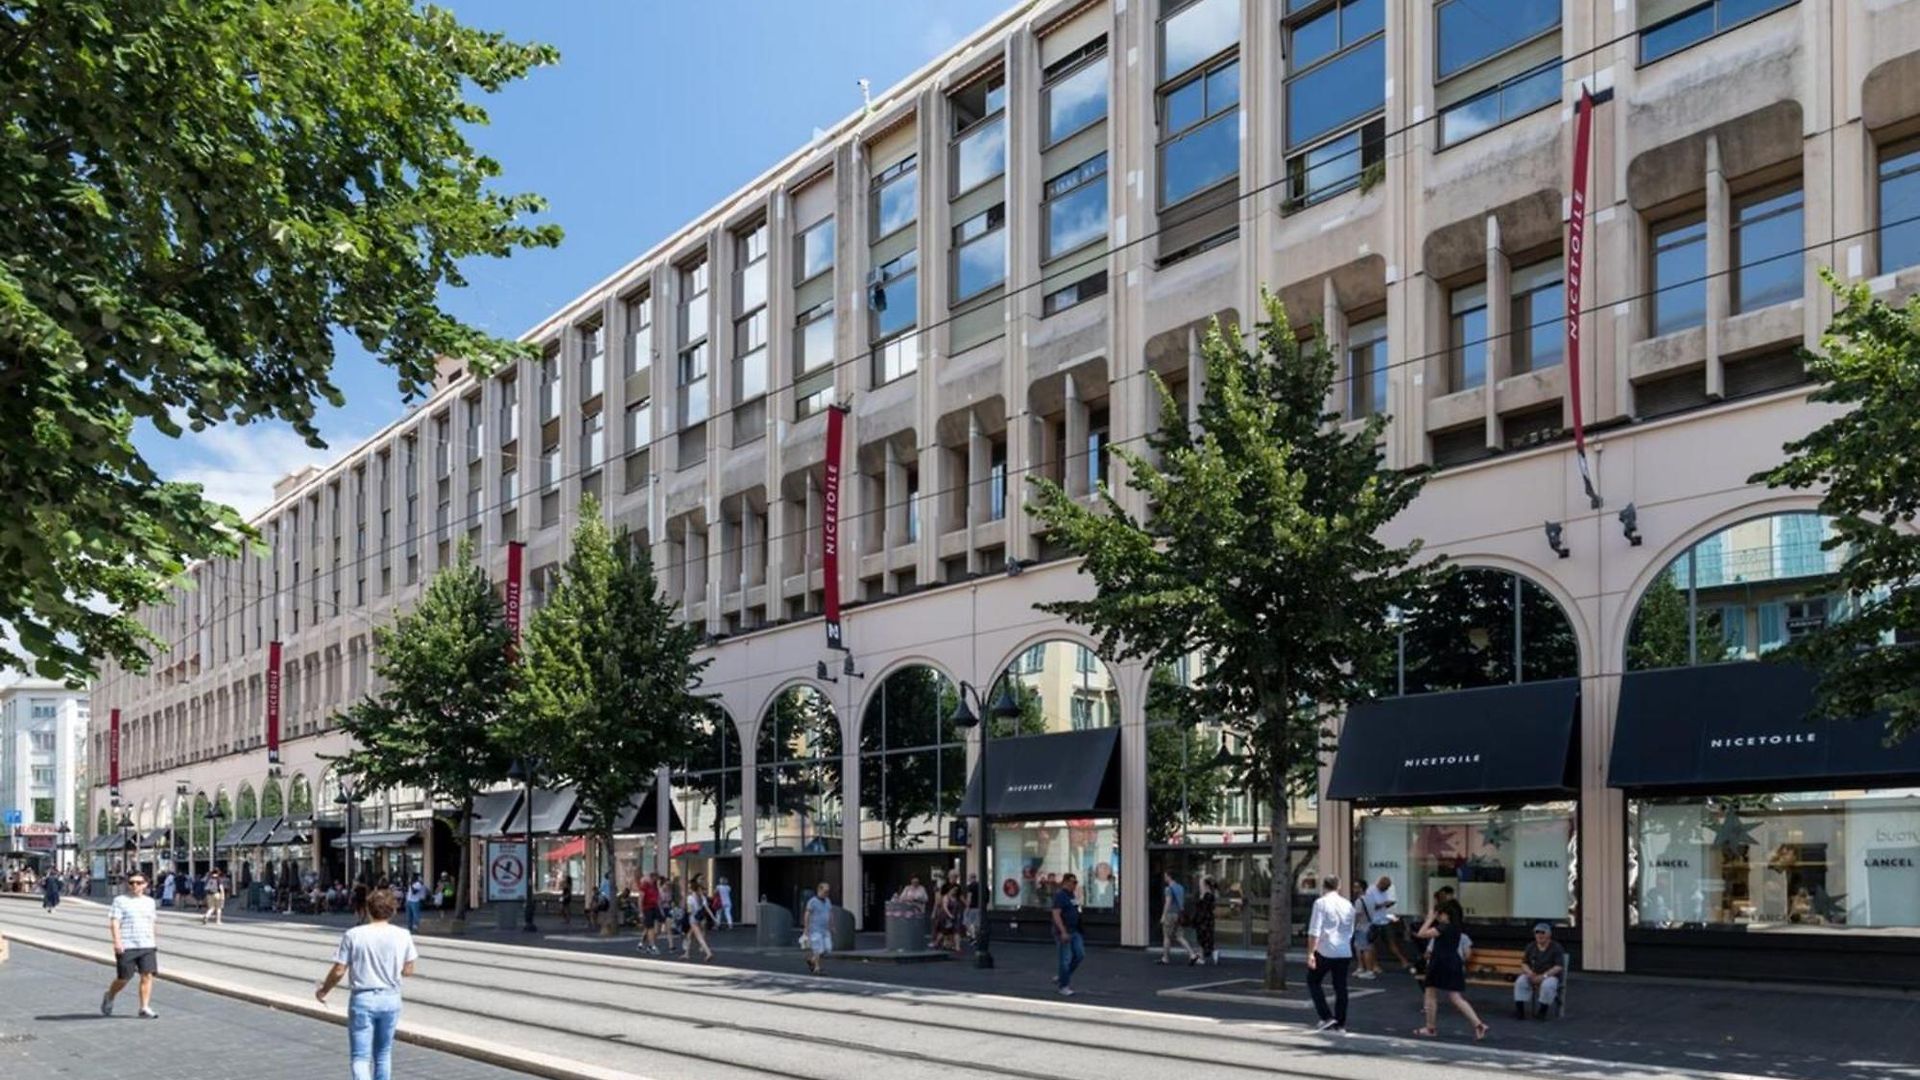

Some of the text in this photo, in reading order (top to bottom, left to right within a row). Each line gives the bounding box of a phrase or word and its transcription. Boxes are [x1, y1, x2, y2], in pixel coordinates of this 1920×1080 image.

[1569, 191, 1583, 340] NICETOILE
[826, 465, 838, 554] NICETOILE
[1711, 733, 1816, 748] NICETOILE
[1404, 754, 1480, 767] NICETOILE
[1369, 861, 1399, 869] LANCEL
[1523, 860, 1560, 868] LANCEL
[1649, 860, 1690, 868] LANCEL
[1864, 858, 1914, 867] LANCEL
